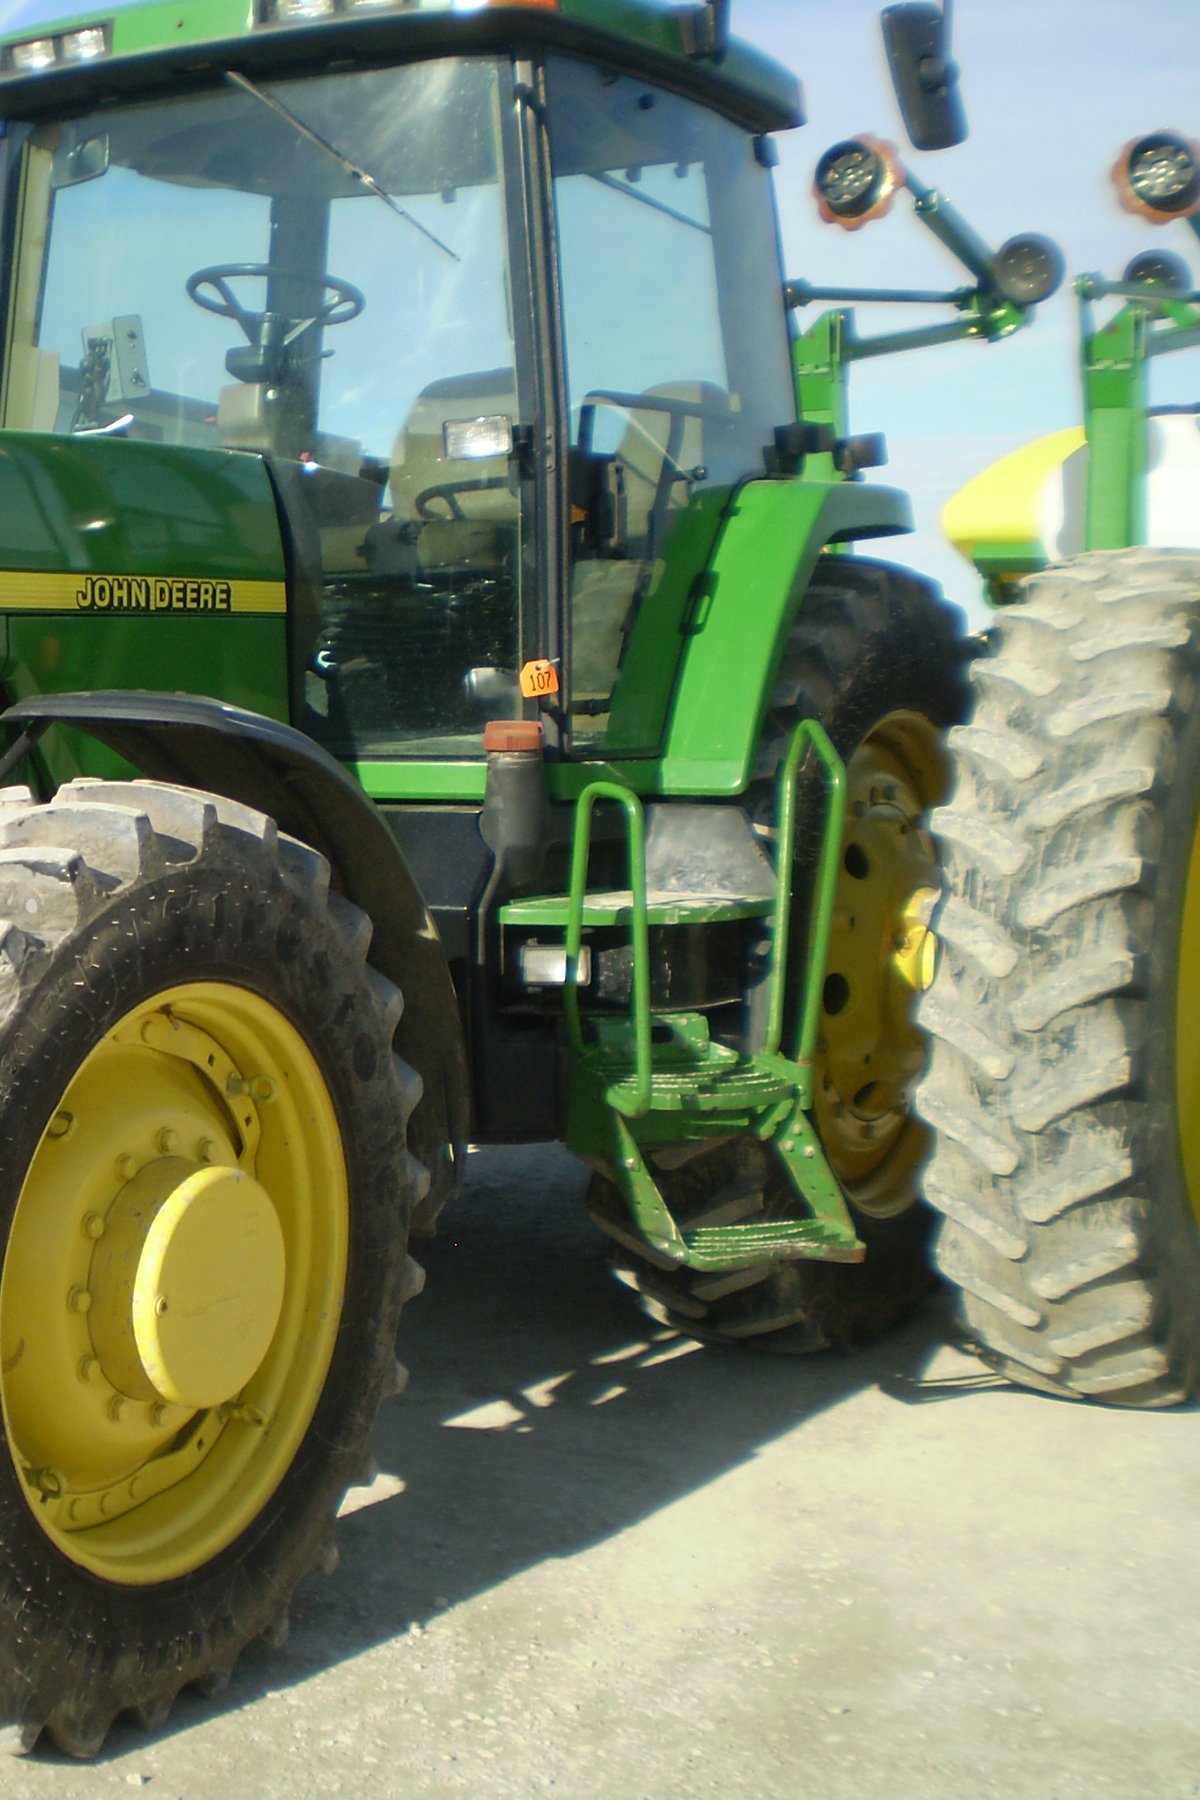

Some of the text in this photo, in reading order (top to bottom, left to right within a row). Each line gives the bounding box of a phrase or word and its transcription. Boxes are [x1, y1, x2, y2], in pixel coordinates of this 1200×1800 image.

[76, 577, 232, 613] JOHN DEERE
[529, 671, 551, 692] 107
